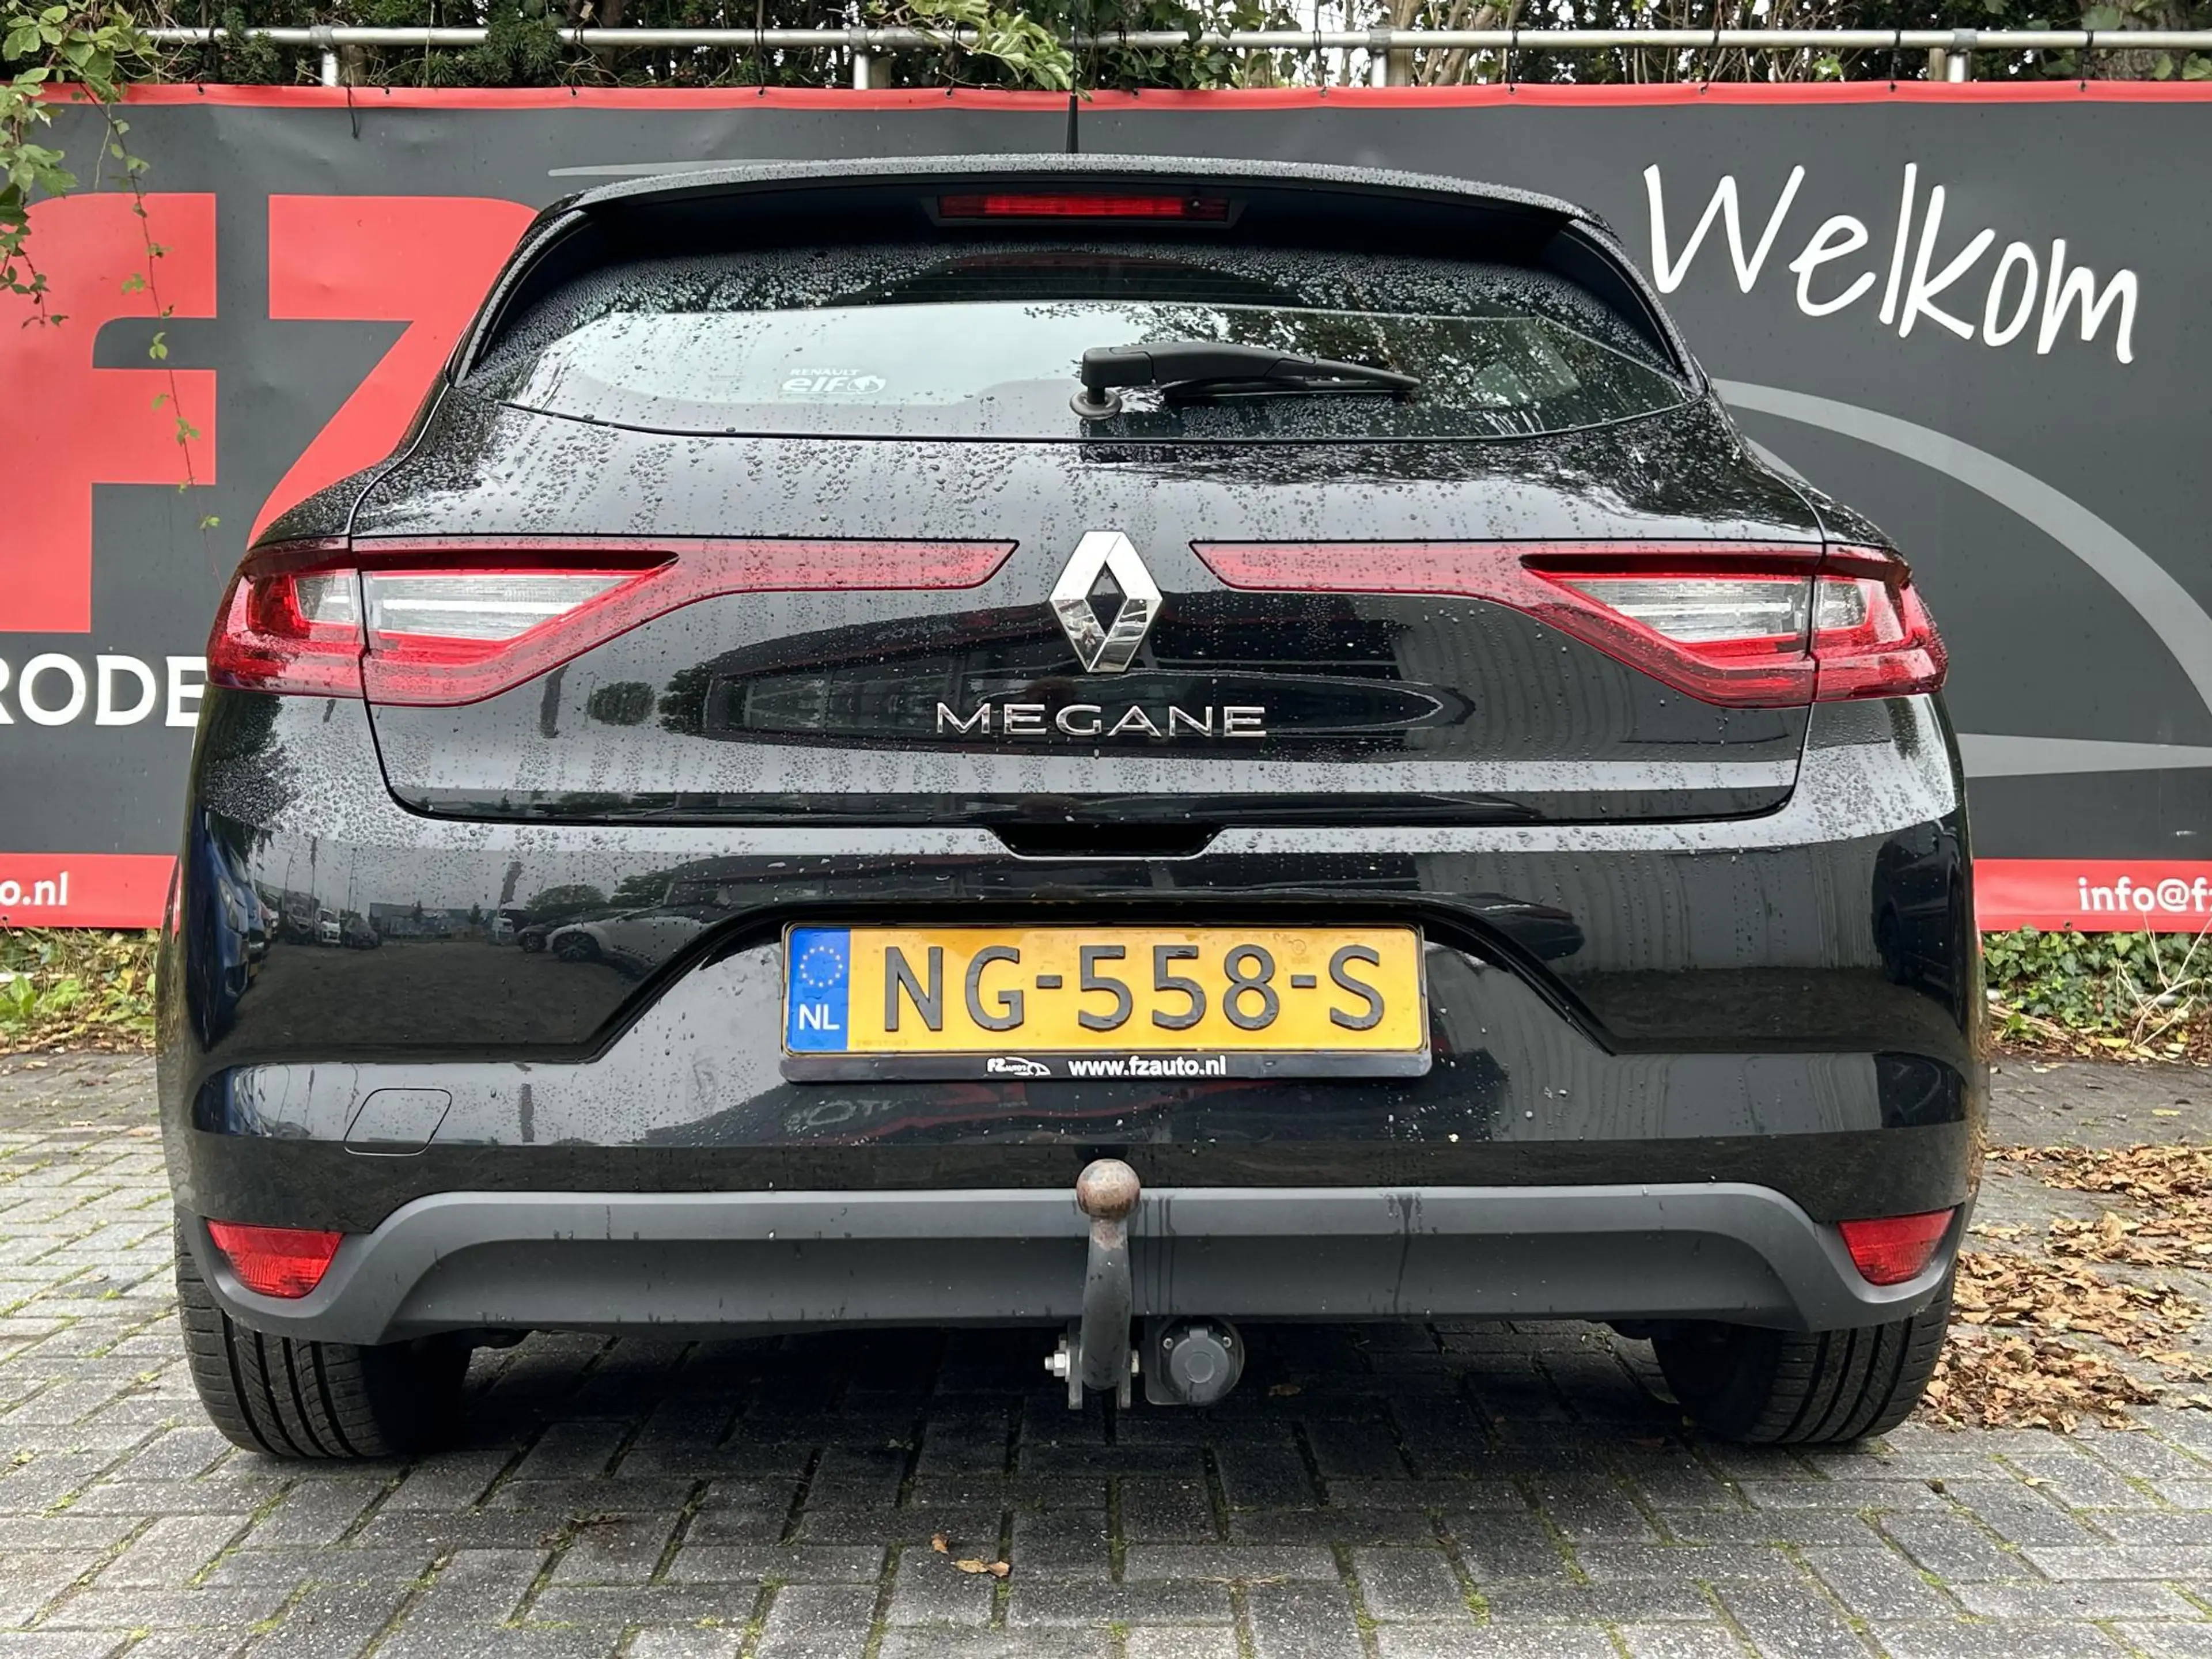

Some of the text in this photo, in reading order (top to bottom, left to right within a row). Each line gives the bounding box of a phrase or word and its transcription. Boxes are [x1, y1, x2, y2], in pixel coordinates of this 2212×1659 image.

[1643, 162, 2138, 364] Welkom
[937, 702, 1267, 737] MEGANE
[2078, 876, 2212, 912] info@f
[885, 944, 1385, 1031] NG-558-S
[799, 1003, 840, 1030] NL
[1067, 1055, 1226, 1075] www.fzauto.nl
